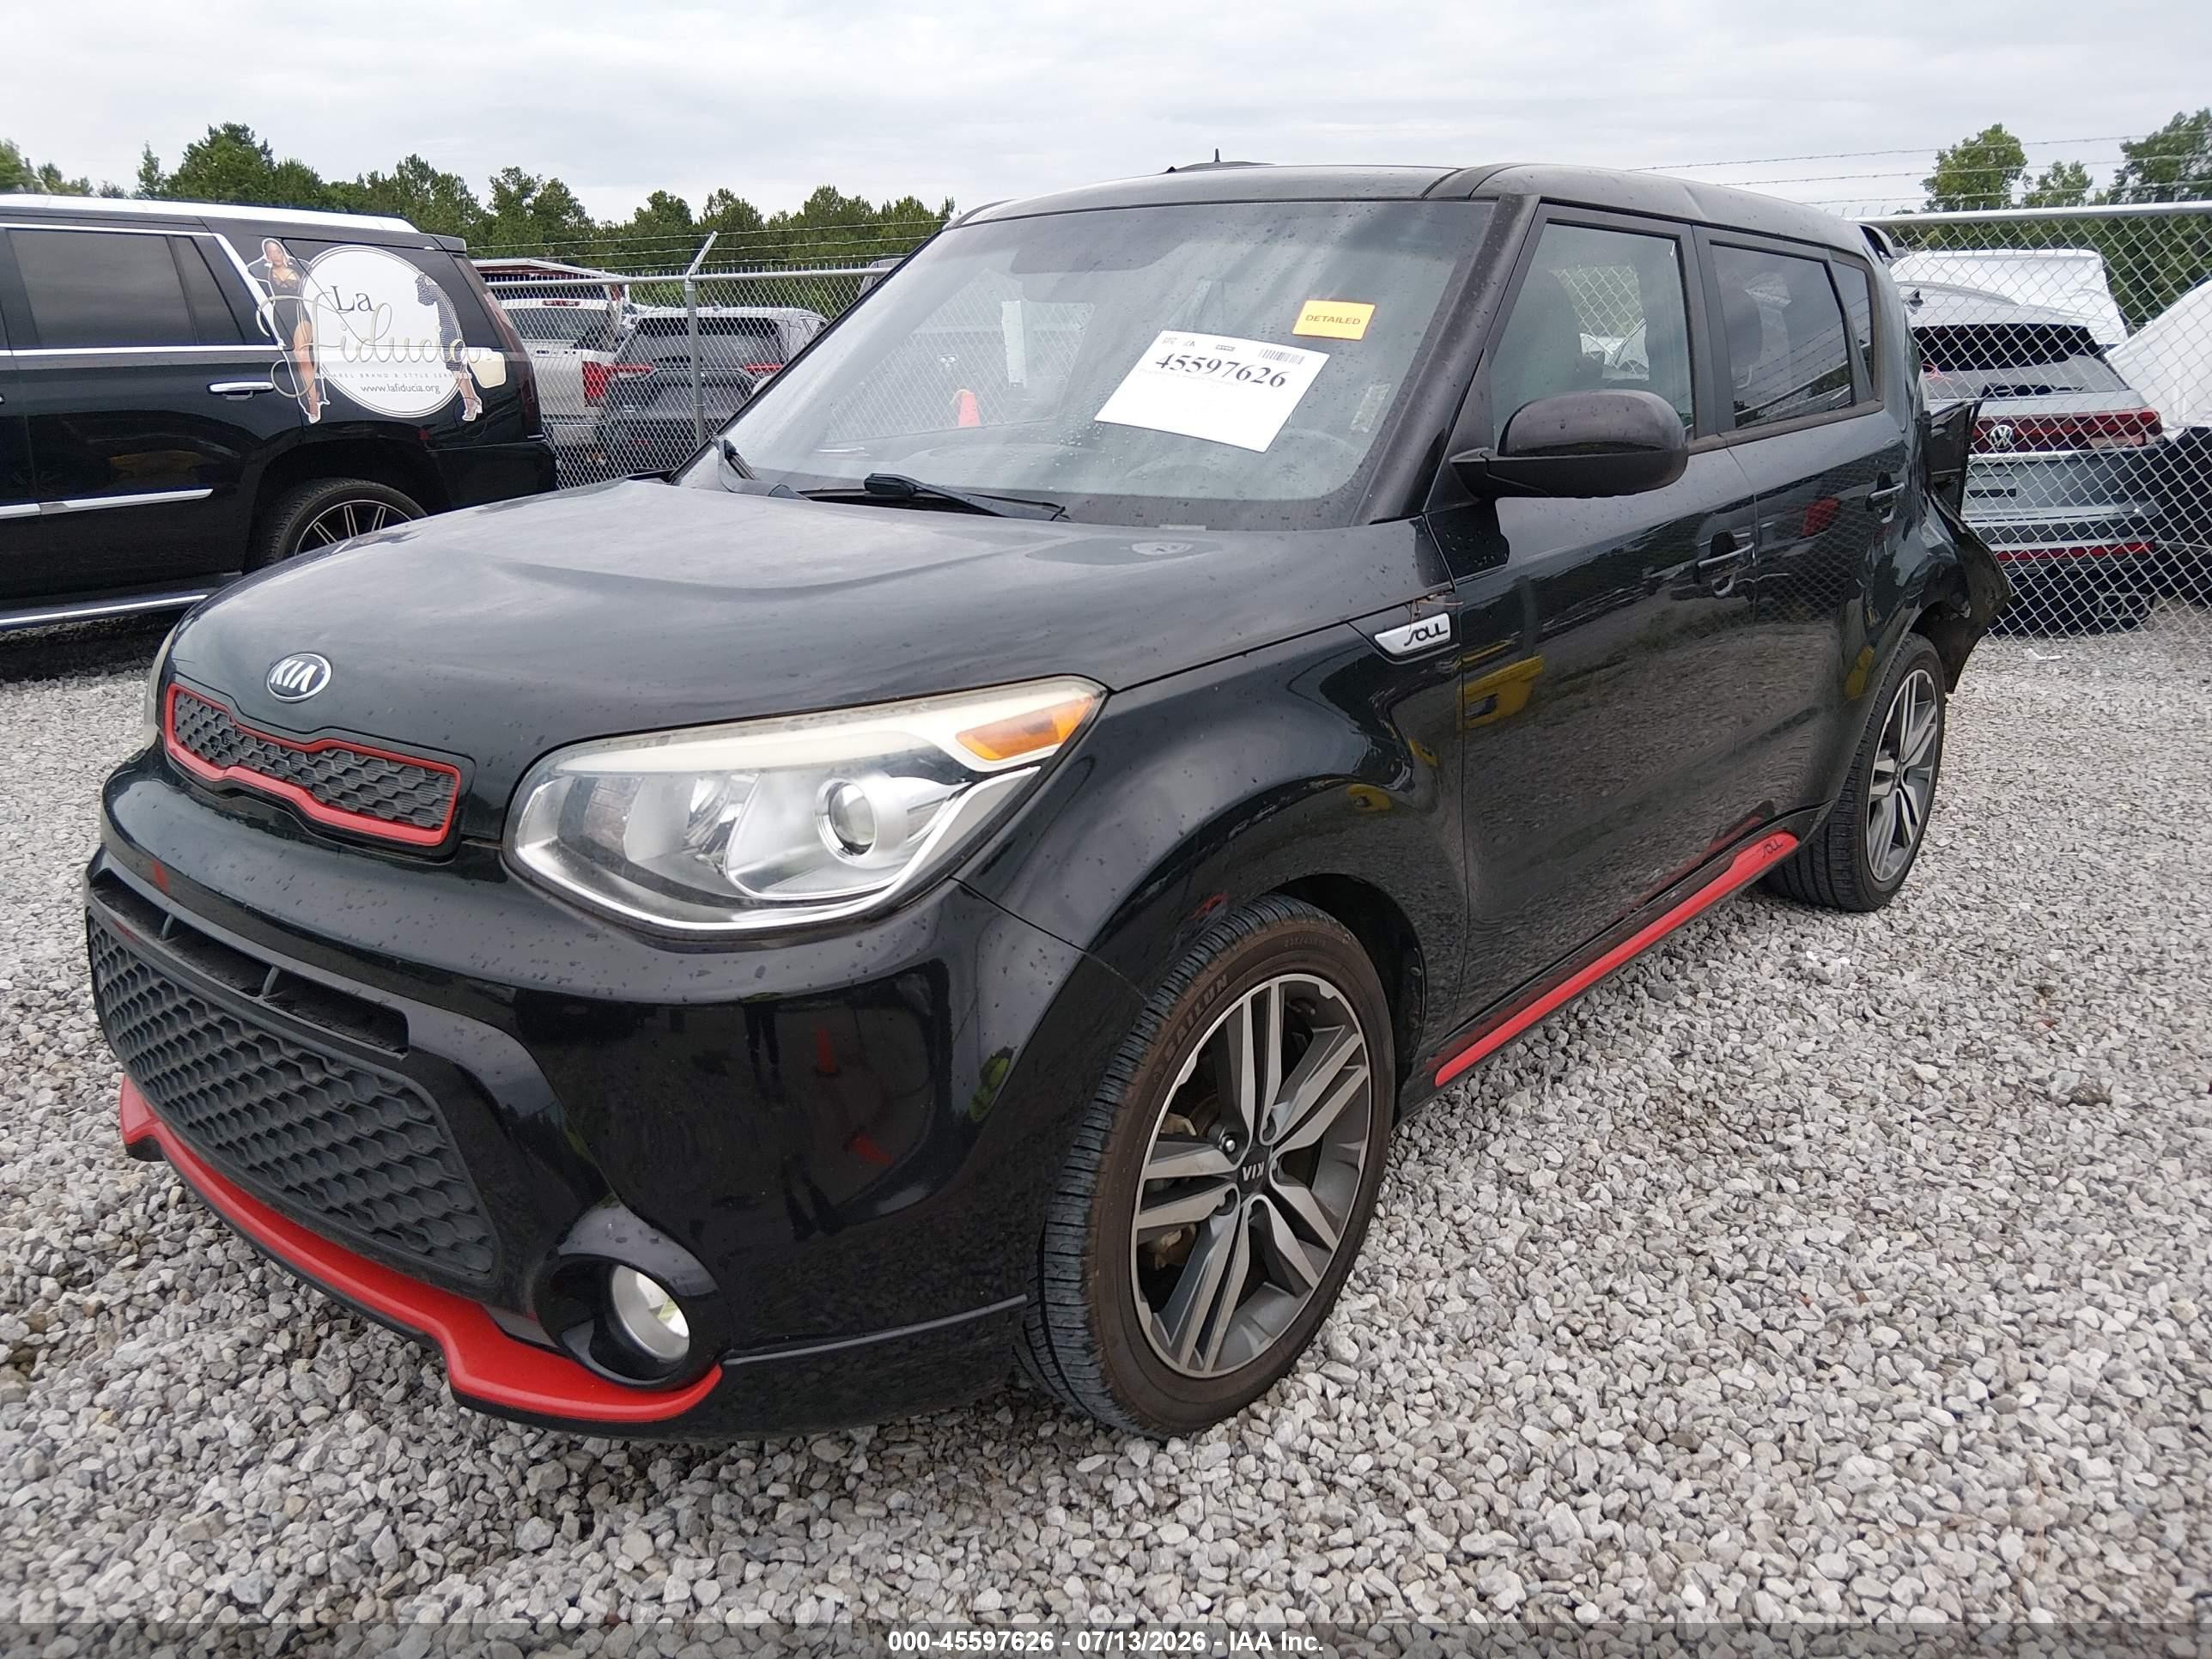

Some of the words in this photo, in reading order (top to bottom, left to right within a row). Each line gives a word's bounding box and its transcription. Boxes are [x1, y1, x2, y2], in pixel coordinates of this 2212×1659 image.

[331, 285, 374, 313] La
[1304, 313, 1362, 326] DETAILED
[256, 294, 481, 398] Fiducia
[1155, 352, 1290, 389] 45597626
[360, 383, 441, 395] www.lafiducia.org
[1404, 623, 1449, 647] SOUL
[270, 659, 318, 693] KIA
[1243, 1162, 1265, 1182] KIA
